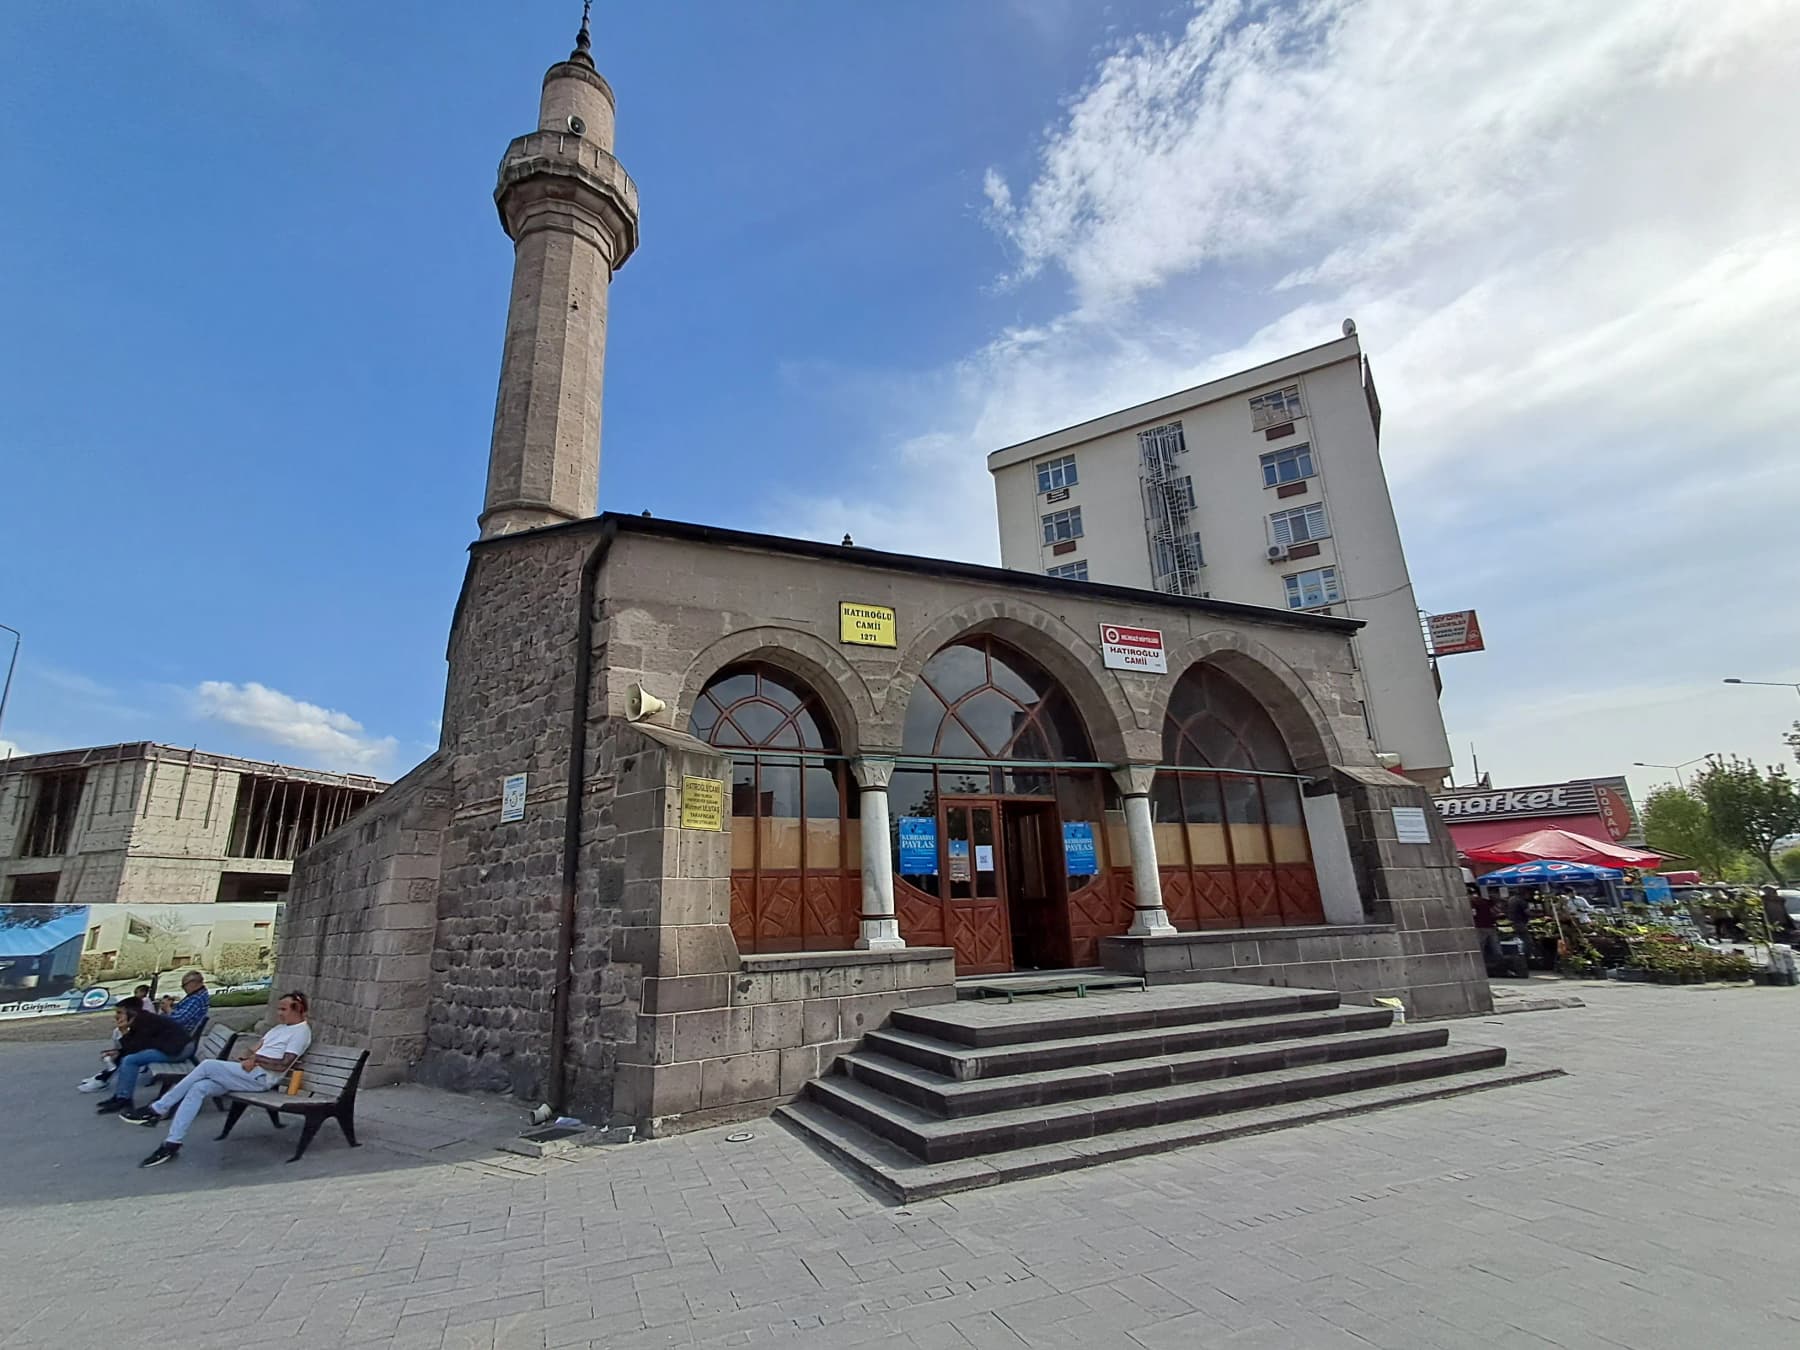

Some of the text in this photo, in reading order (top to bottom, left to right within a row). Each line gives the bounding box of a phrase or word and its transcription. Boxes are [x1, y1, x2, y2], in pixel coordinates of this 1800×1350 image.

[844, 607, 892, 621] HATIROĞLU
[861, 633, 877, 641] 1271
[1110, 646, 1159, 658] HATIROĞLU
